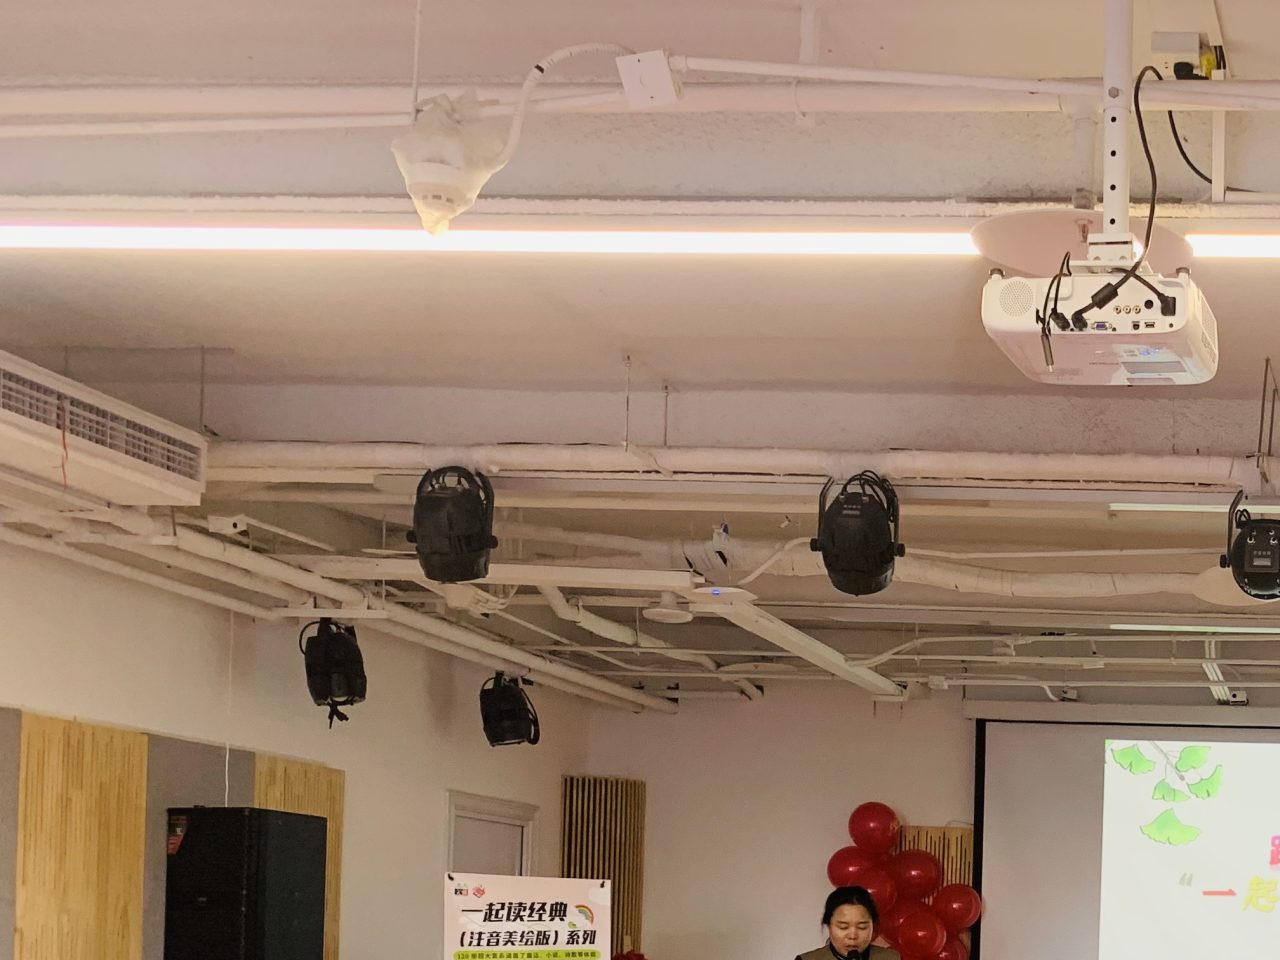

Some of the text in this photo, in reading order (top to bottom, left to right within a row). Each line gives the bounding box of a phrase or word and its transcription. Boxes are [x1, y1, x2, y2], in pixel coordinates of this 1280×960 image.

[461, 901, 568, 922] 一起读经典
